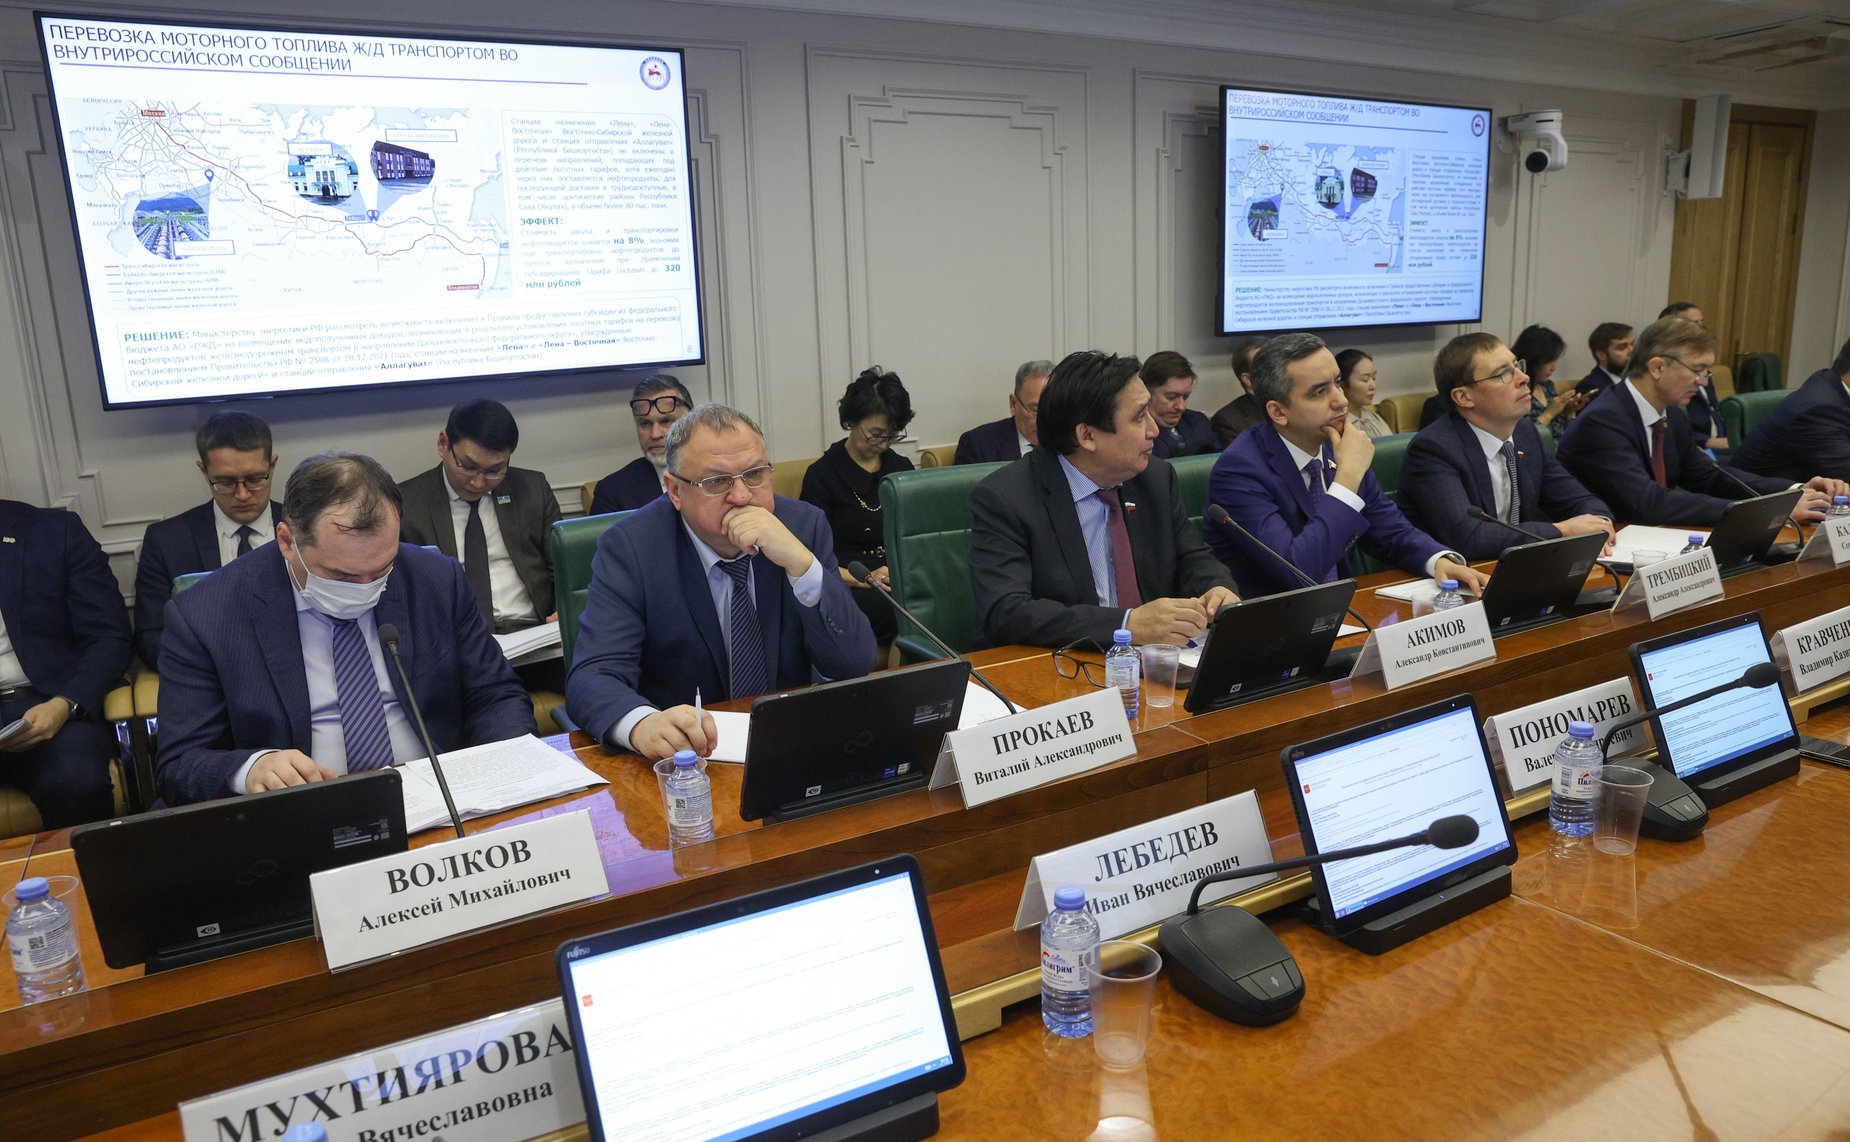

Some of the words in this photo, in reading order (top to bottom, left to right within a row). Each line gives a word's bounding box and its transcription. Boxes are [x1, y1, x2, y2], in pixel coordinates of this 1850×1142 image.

[49, 25, 156, 44] ПЕРЕВОЗКА
[161, 32, 268, 53] МОТОРНОГО
[272, 38, 348, 54] ТОПЛИВА
[352, 42, 385, 58] Ж/Д
[388, 43, 495, 60] ТРАНСПОРТОМ
[499, 49, 519, 61] ВО
[53, 43, 244, 66] ВНУТРИРОССИЙСКОМ
[248, 55, 352, 73] СООБЩЕНИИ
[1229, 93, 1270, 107] ПЕРЕВОЗКА
[1272, 97, 1315, 110] МОТОРНОГО
[1317, 100, 1348, 113] ТОПЛИВА
[1365, 104, 1410, 117] ТРАНСПОРТОМ
[1412, 108, 1420, 118] ВО
[1229, 104, 1304, 120] ВНУТРИРОССИЙСКОМ
[1306, 111, 1349, 124] СООБЩЕНИИ
[519, 217, 564, 226] ЭФФЕКТ:
[665, 264, 681, 272] 320
[526, 281, 545, 289] млн
[547, 279, 581, 289] рублей
[124, 331, 190, 342] РЕШЕНИЕ:
[686, 344, 693, 353] 8
[1646, 554, 1712, 588] ТРЕМБИЦКИЙ
[1652, 589, 1680, 603] Александр
[1680, 577, 1716, 594] Александрович
[1407, 619, 1466, 648] АКИМОВ
[1797, 620, 1850, 654] КРАВЧЕН
[1395, 652, 1432, 669] Александр
[1432, 637, 1486, 658] Константинович
[1799, 656, 1834, 675] Владимир
[992, 711, 1094, 755] ПРОКАЕВ
[974, 758, 1031, 786] Виталий
[1033, 733, 1123, 768] Александрович
[384, 839, 532, 895] ВОЛКОВ
[1094, 821, 1219, 882] ЛЕБЕДЕВ
[358, 897, 443, 933] Алексей
[448, 868, 572, 910] Михайлович
[1086, 892, 1131, 916] Иван
[1133, 855, 1241, 902] Вячеславович
[567, 946, 590, 959] FUJITSU
[213, 1023, 573, 1142] МУХТИЯРОВА
[358, 1082, 553, 1142] Вячеславовна
